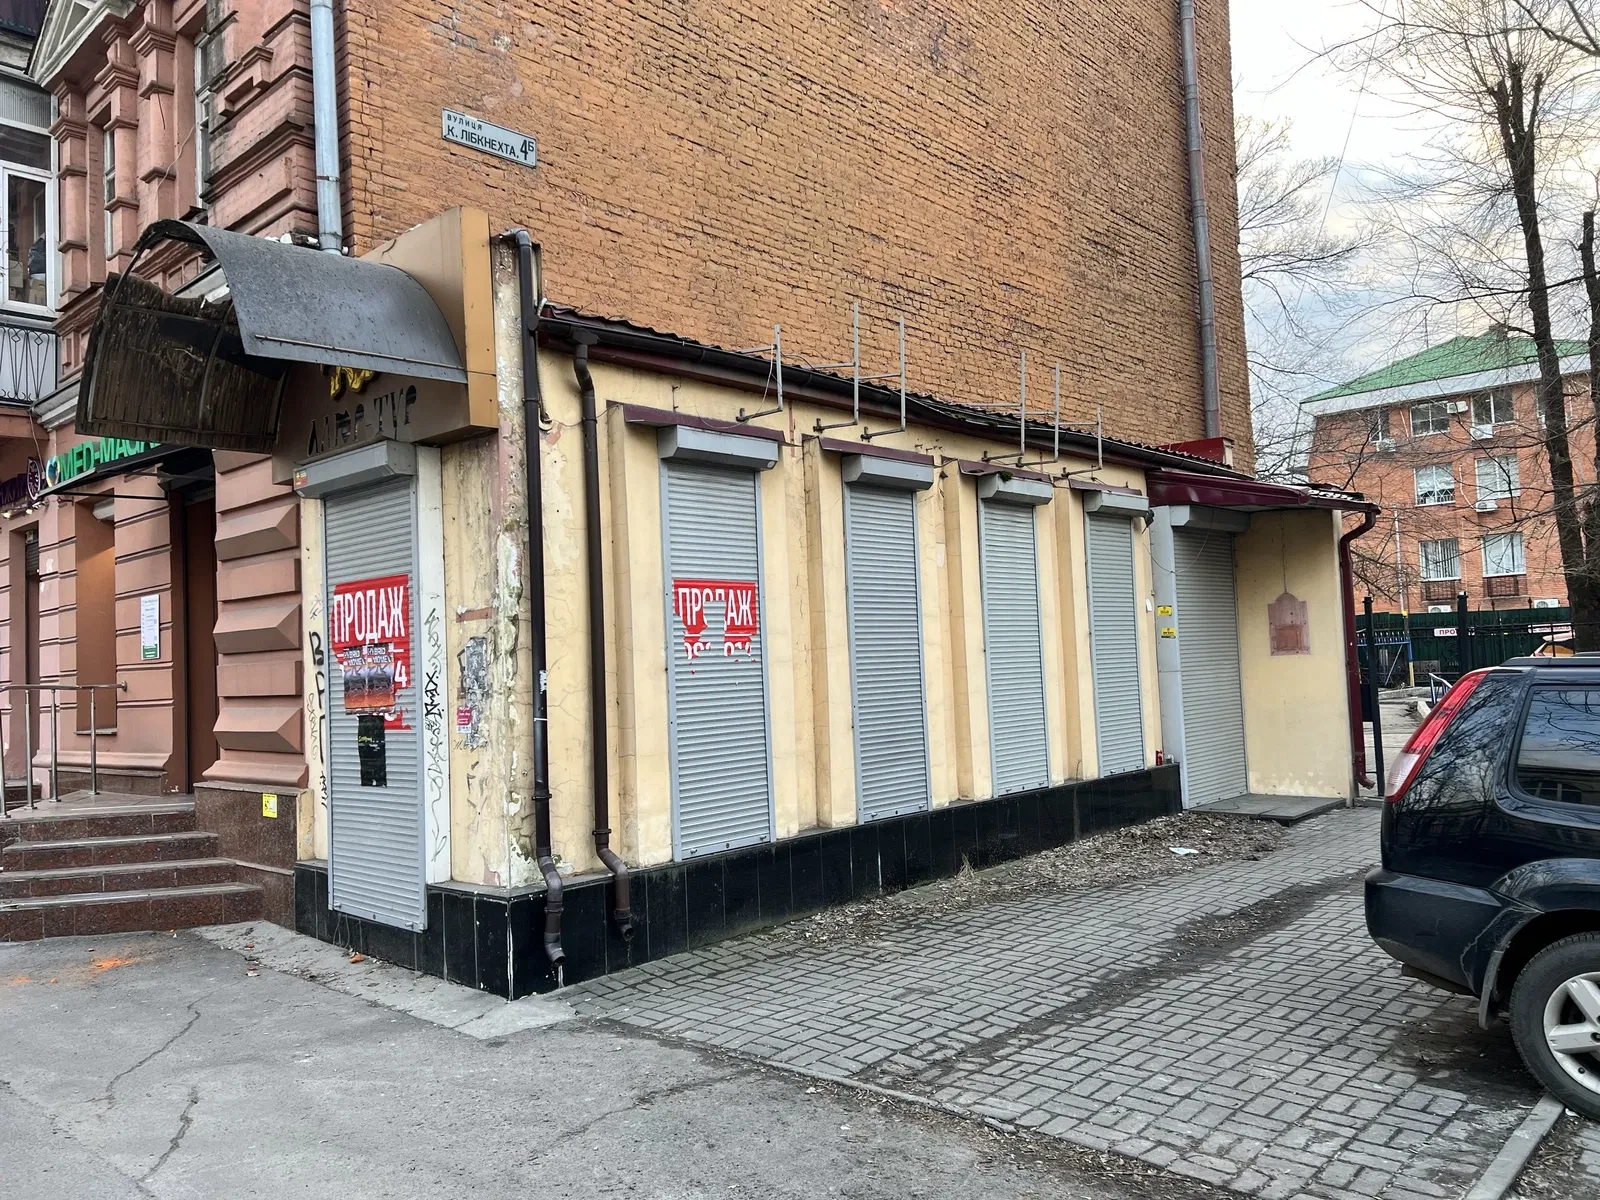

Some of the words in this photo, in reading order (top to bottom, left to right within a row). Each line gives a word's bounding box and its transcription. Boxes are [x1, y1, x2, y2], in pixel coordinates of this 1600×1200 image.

[447, 113, 483, 131] ВУЛИЦЯ
[447, 125, 458, 138] К.
[520, 139, 534, 161] 4Б
[334, 586, 405, 644] ПРОДАЖ
